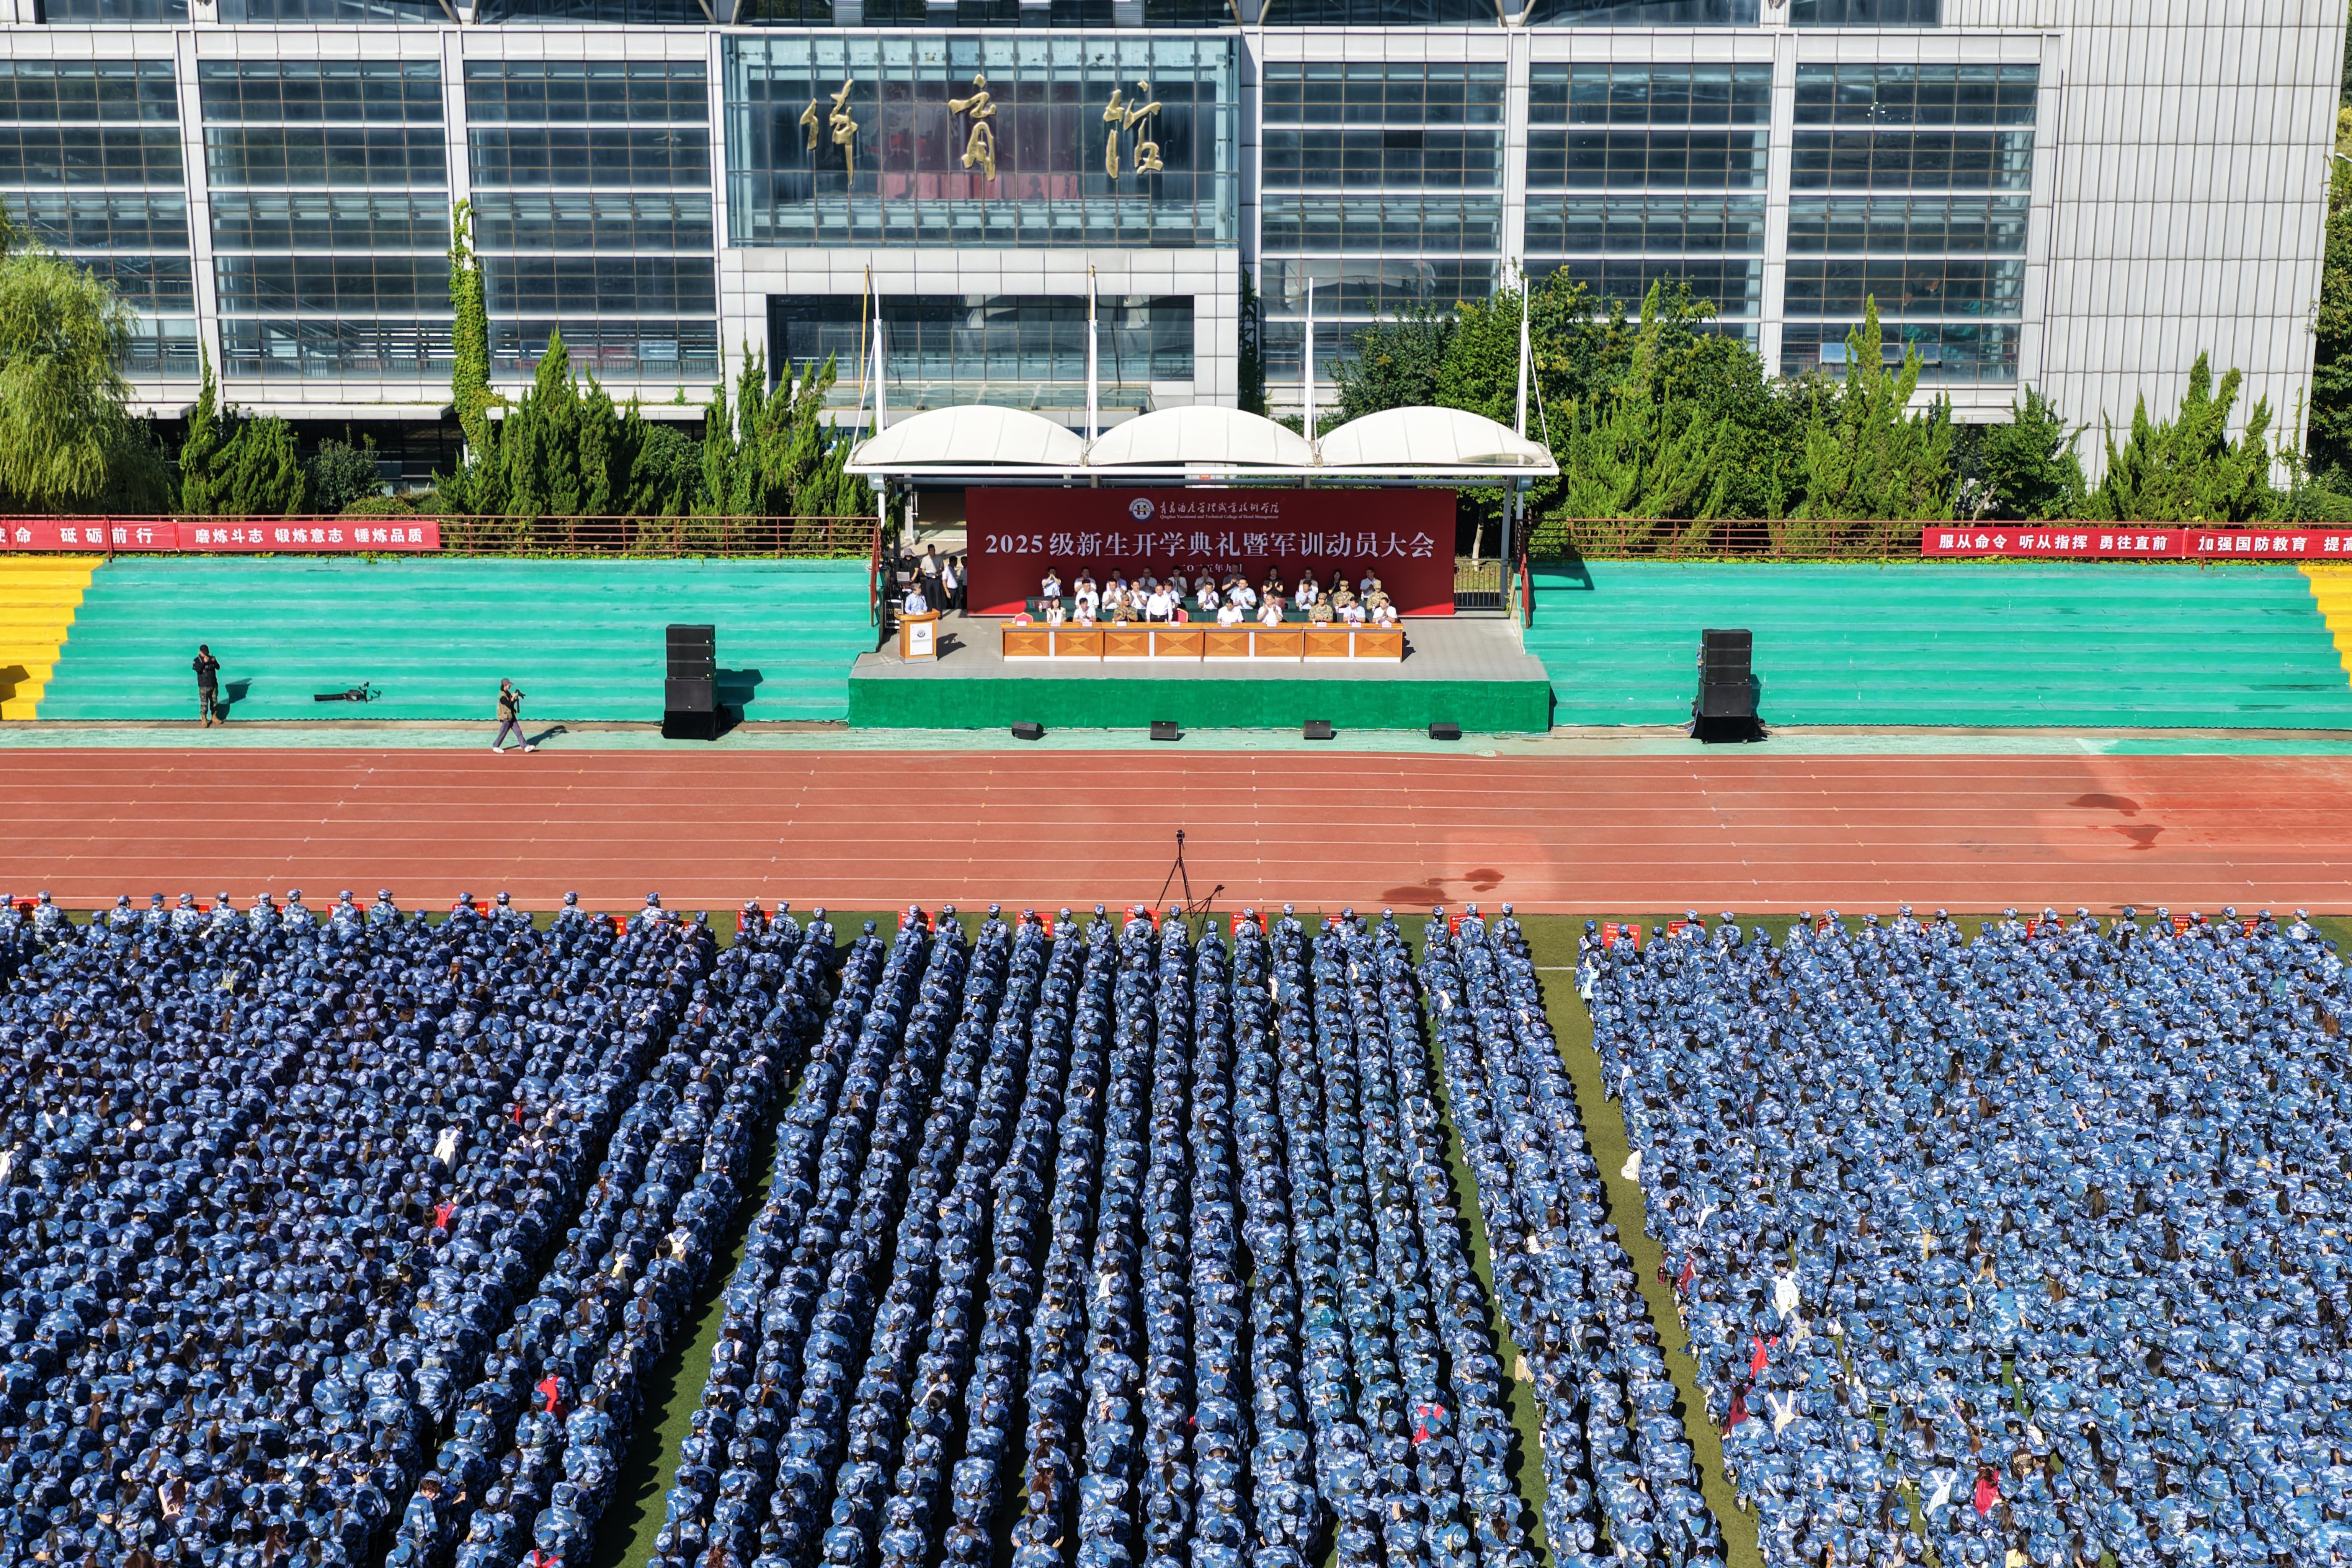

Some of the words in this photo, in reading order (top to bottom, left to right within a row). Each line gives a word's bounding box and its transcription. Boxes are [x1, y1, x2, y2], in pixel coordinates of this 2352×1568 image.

[60, 527, 153, 544] 砥砺前行
[195, 528, 264, 544] 磨炼斗志
[274, 528, 343, 543] 锻炼意志
[354, 528, 423, 543] 锤炼品质
[1939, 534, 2008, 549] 服从命令
[2019, 534, 2088, 550] 听从指挥
[2099, 535, 2168, 550] 勇往直前
[985, 531, 1435, 557] 2025级新生开学典礼暨军训动员大会
[2198, 536, 2308, 552] 加强国防教育
